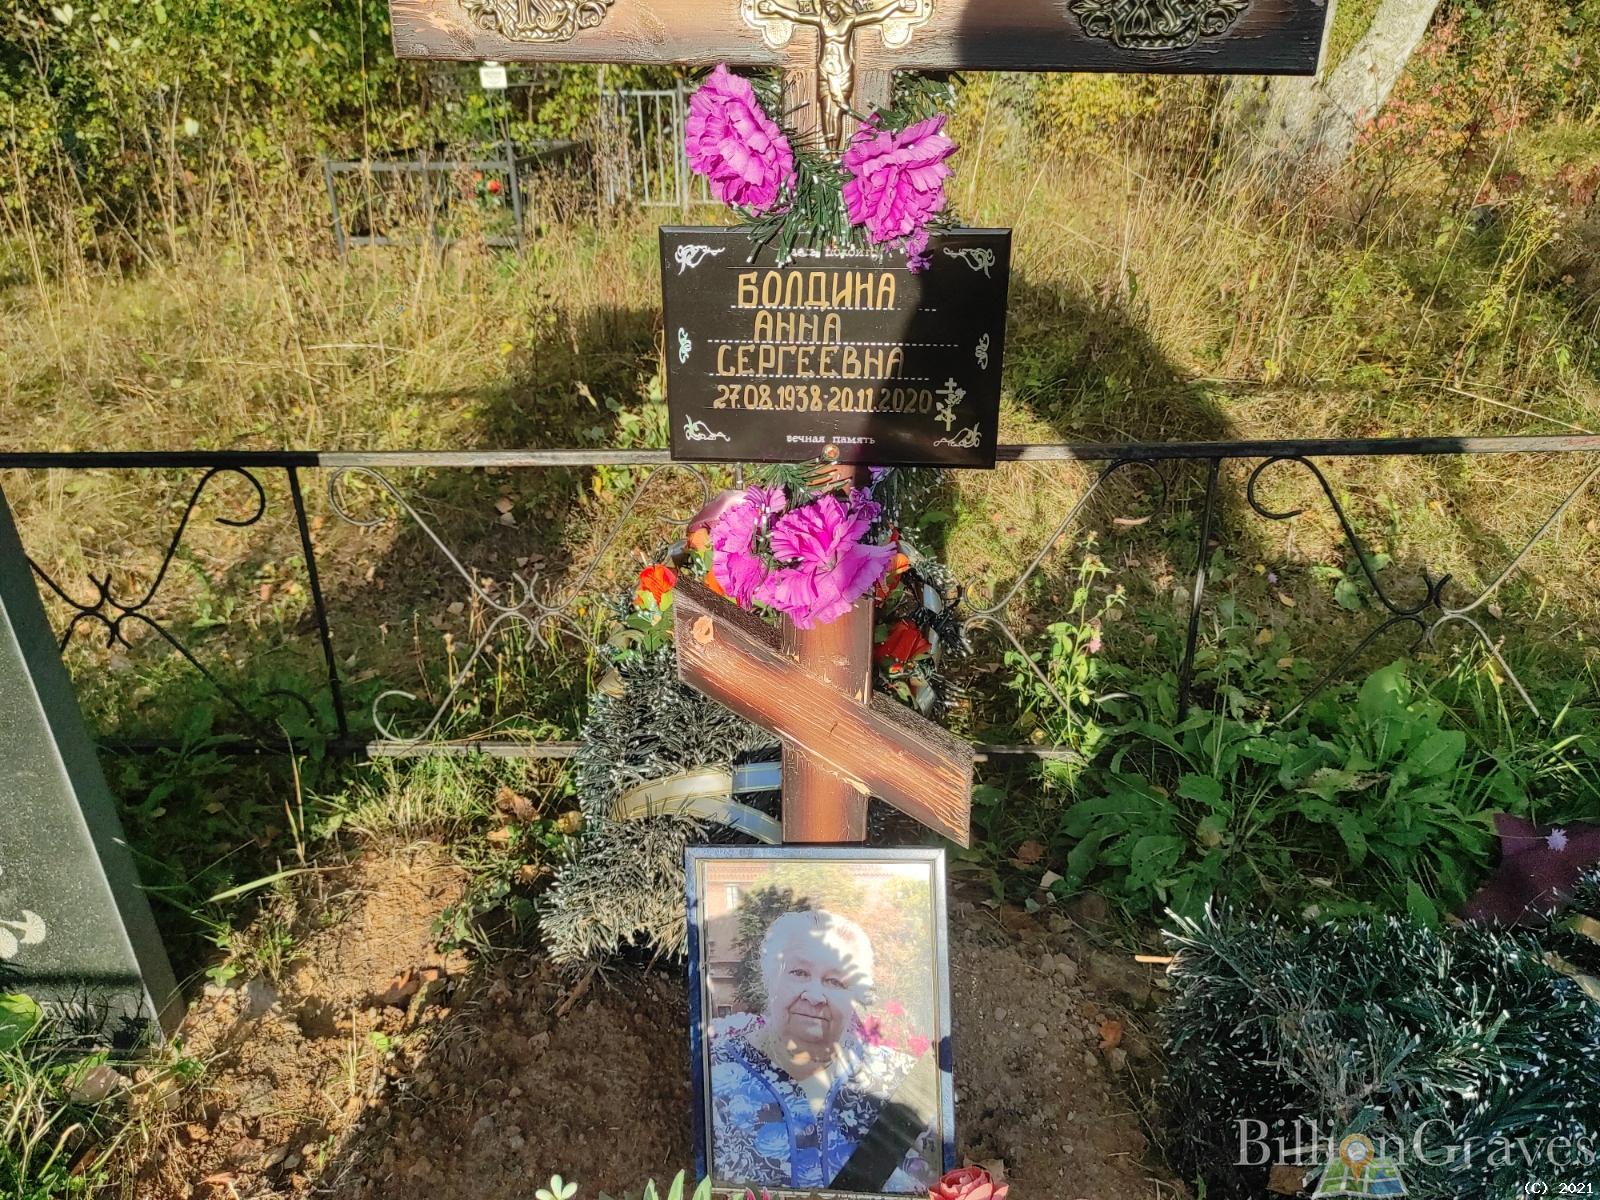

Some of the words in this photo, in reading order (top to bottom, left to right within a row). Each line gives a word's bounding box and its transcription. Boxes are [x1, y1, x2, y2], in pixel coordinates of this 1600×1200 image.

[737, 270, 897, 311] БОЛДИНА
[753, 309, 842, 345] АННА
[717, 344, 904, 379] СЕРГЕЕВНА
[786, 434, 826, 444] вечная
[832, 434, 876, 445] память
